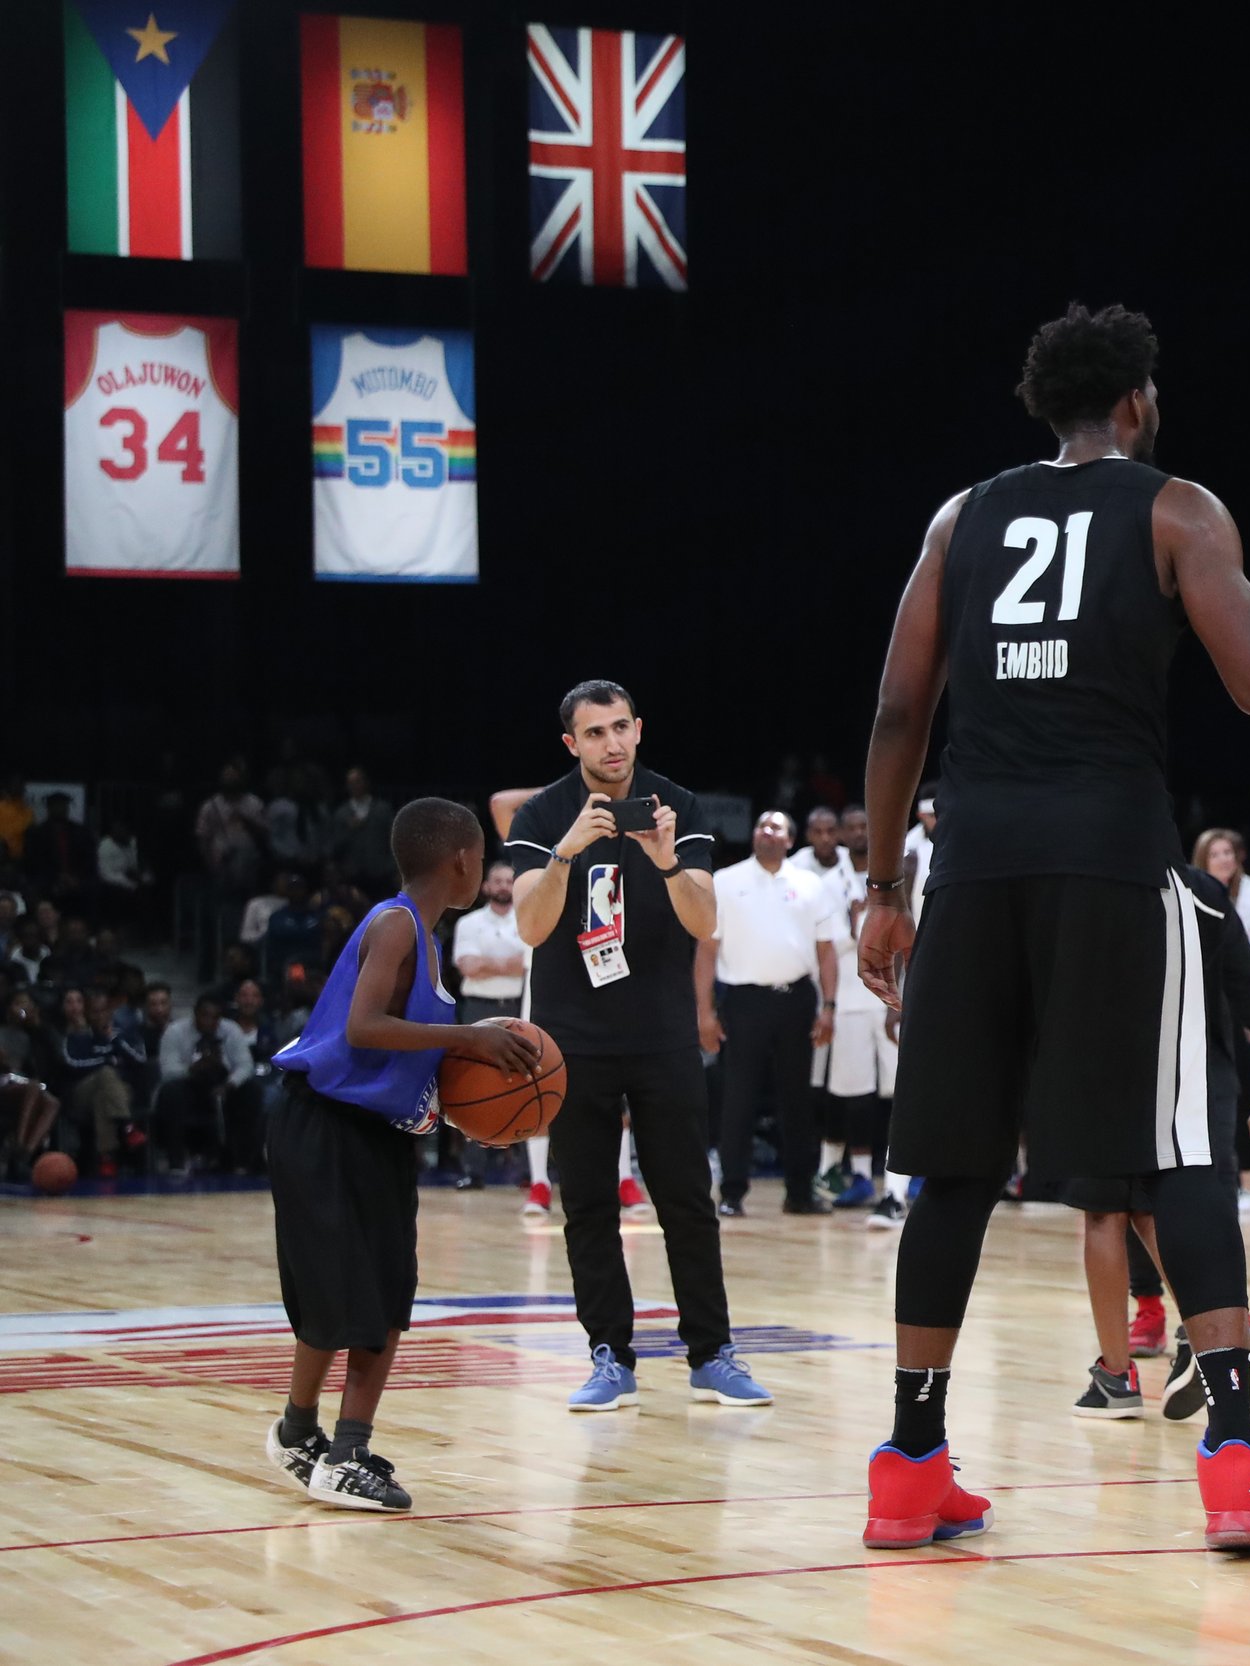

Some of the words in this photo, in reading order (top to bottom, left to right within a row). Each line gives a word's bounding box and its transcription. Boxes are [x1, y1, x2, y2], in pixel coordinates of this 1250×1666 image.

[97, 362, 206, 398] OLAJUWON
[352, 366, 439, 401] MUTOMBO
[99, 407, 206, 483] 34
[346, 419, 446, 489] 55
[992, 511, 1094, 624] 21
[995, 639, 1069, 680] EMBIID
